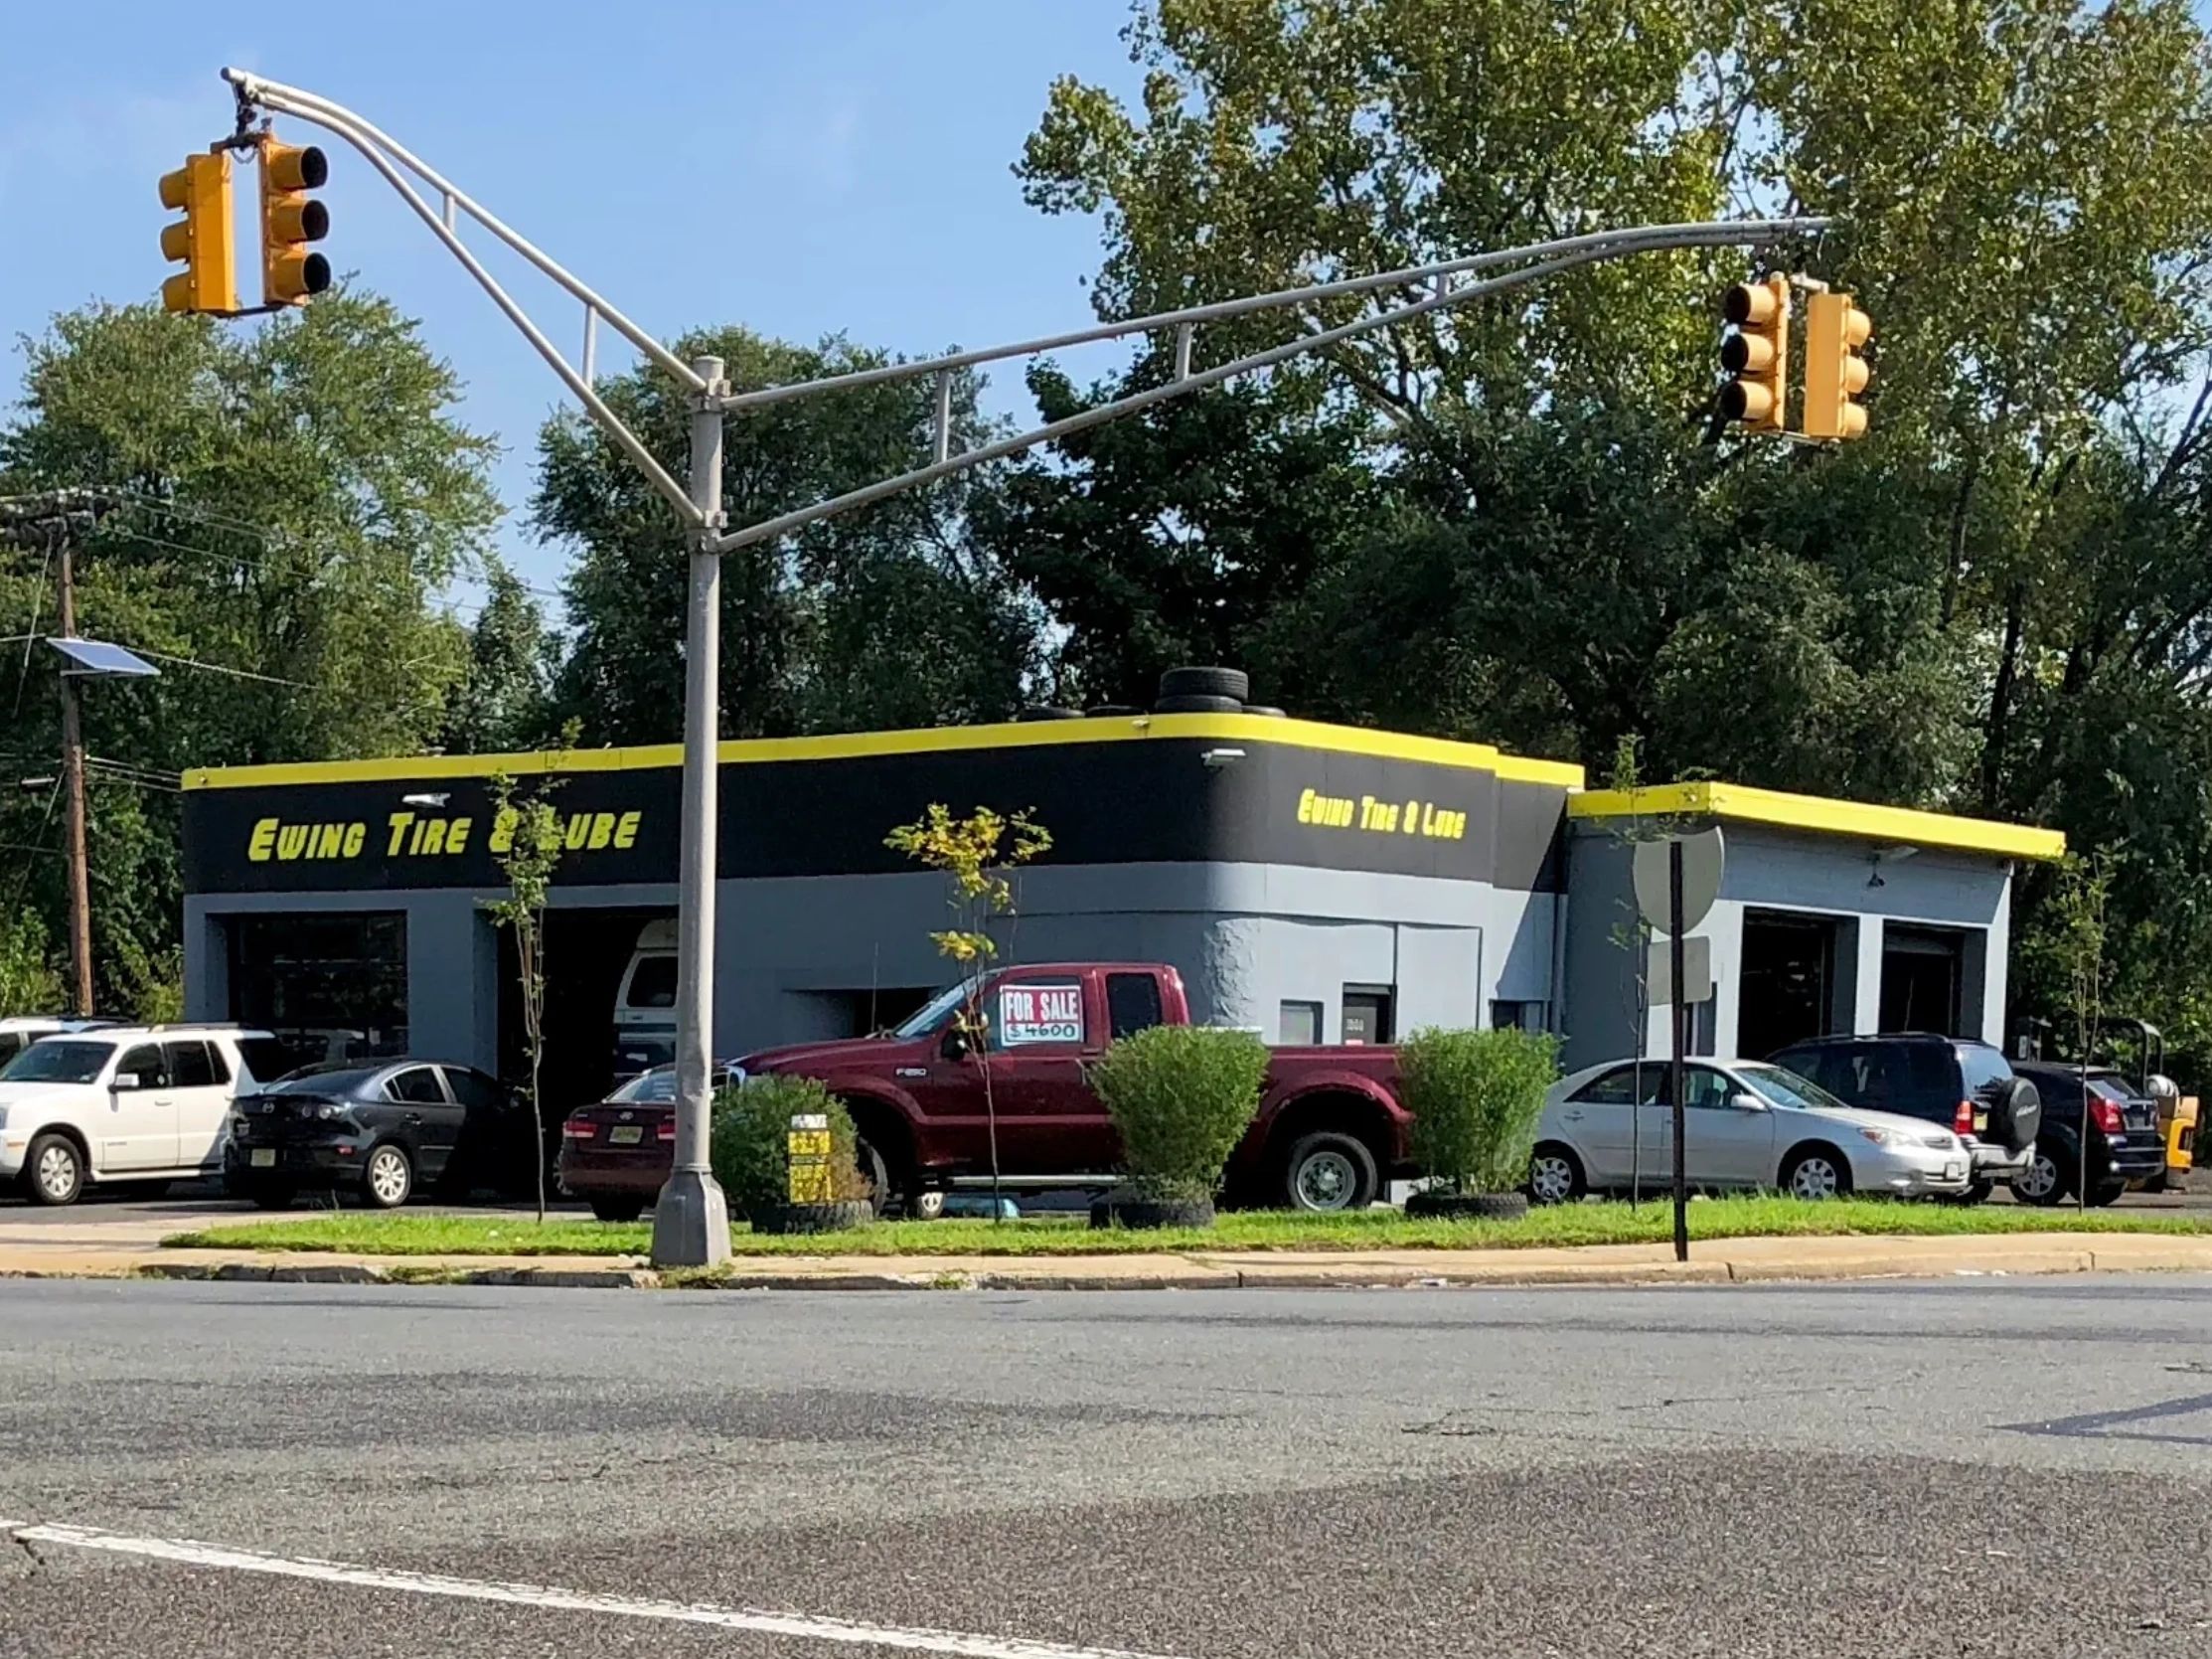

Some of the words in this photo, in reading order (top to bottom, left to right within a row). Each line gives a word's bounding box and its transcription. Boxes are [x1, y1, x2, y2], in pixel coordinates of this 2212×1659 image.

[247, 818, 366, 862] EWING
[387, 811, 472, 856] TIRE
[489, 807, 519, 853] &
[1005, 992, 1033, 1022] FOR
[1039, 992, 1078, 1022] SALE
